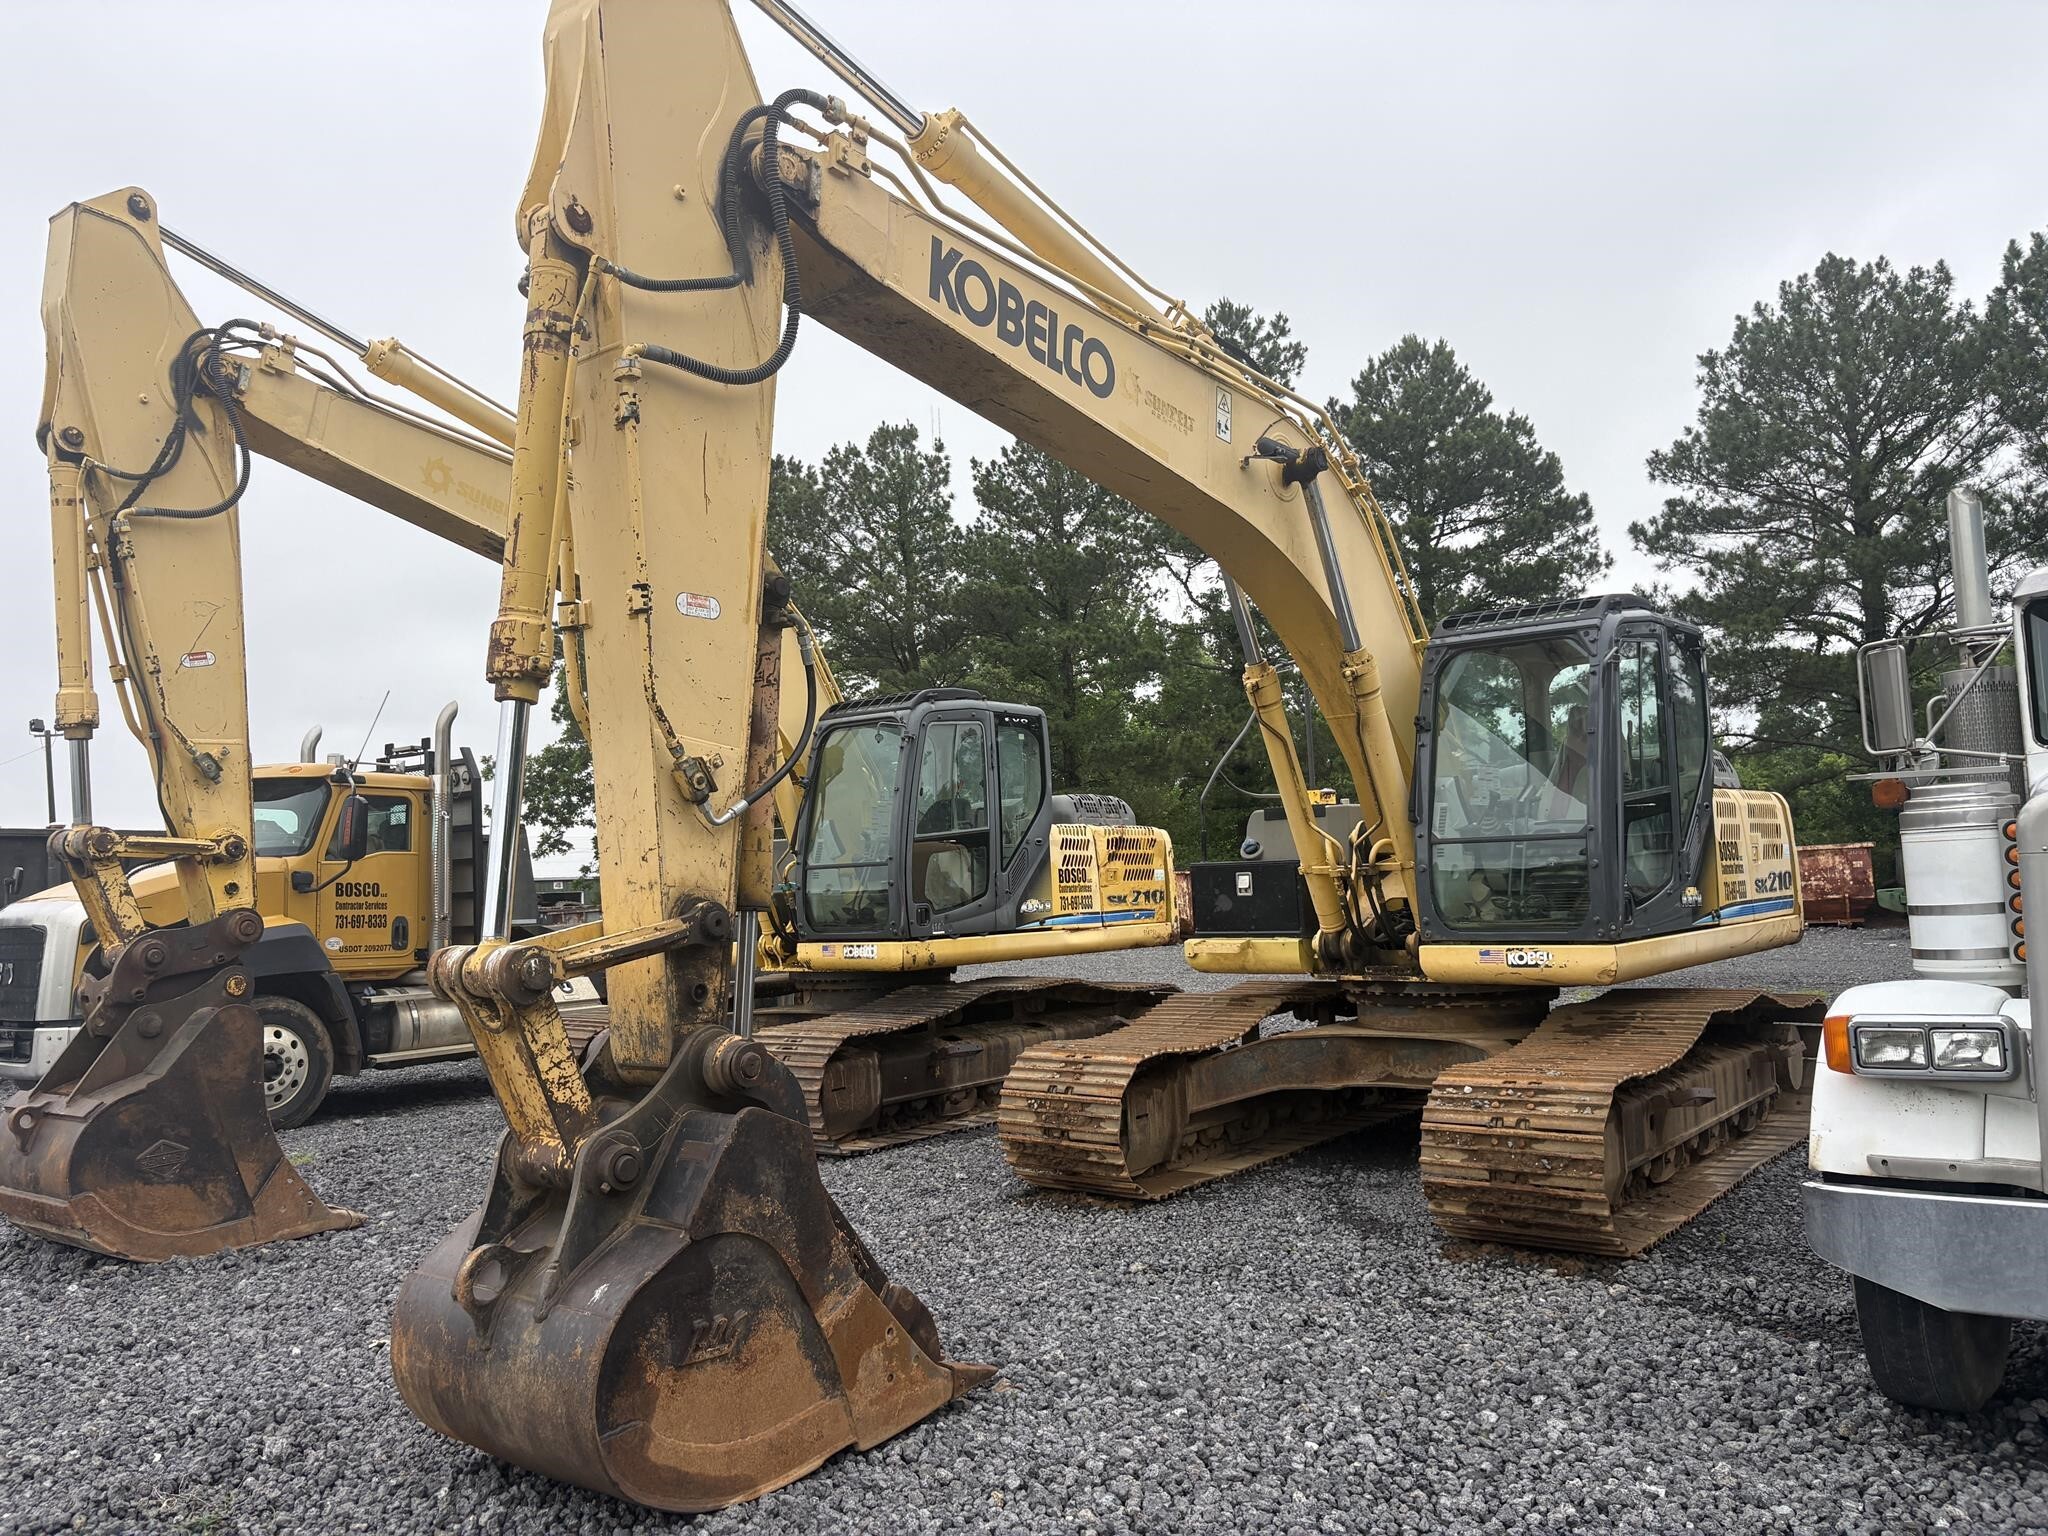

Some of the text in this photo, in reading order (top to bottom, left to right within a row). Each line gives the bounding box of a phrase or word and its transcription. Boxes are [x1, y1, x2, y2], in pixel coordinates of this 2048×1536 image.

[929, 235, 1115, 398] KOBELCO
[456, 480, 506, 515] SUNB
[1058, 868, 1086, 884] BOSCO
[1755, 871, 1792, 893] SK210
[335, 882, 380, 897] BOSCO
[335, 901, 388, 910] Contractor Services
[335, 914, 387, 929] 731-697-8333
[364, 944, 392, 952] 2092077
